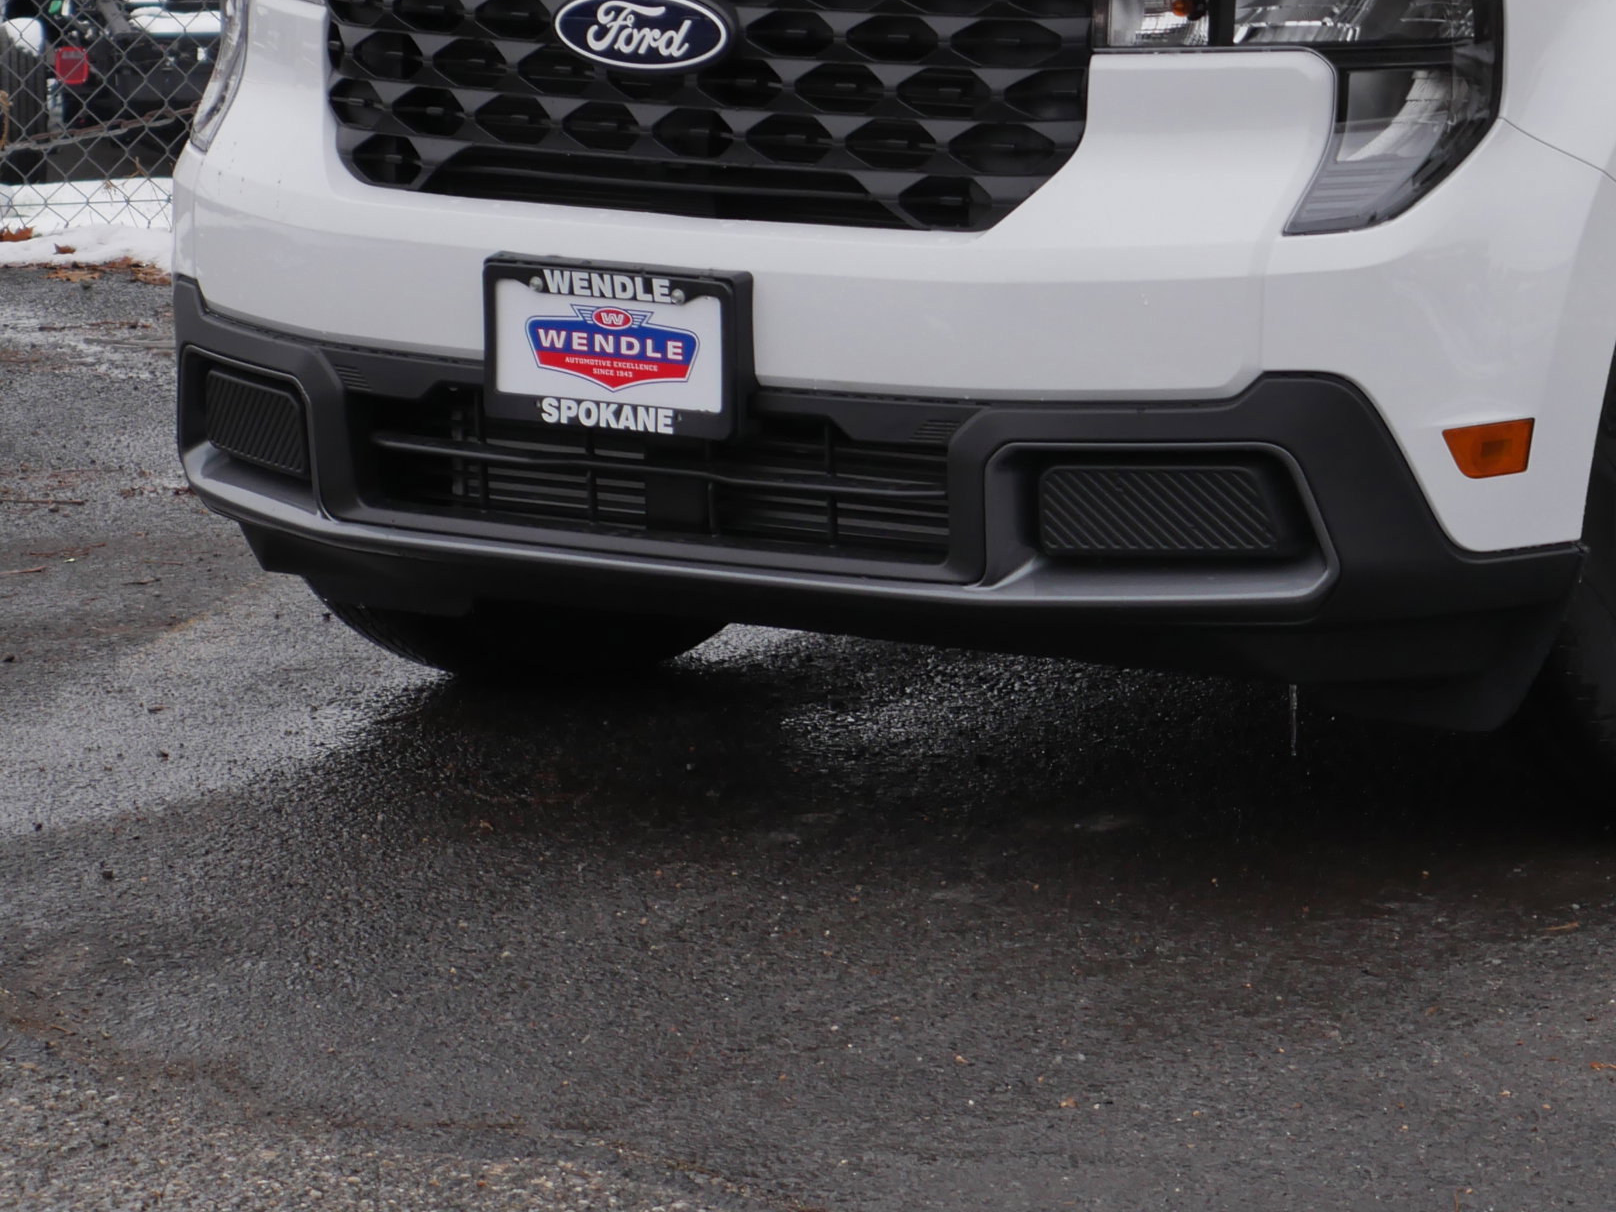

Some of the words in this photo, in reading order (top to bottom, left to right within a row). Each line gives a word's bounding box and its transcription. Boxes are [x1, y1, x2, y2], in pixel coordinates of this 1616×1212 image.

[586, 0, 692, 58] Ford
[543, 269, 673, 303] WENDLE
[537, 329, 683, 359] WENDLE
[565, 356, 612, 367] AUTOMOTIVE
[613, 361, 658, 372] EXCELLENCE
[592, 367, 615, 376] SINCE
[616, 370, 633, 378] 1943
[541, 397, 674, 434] SPOKANE
